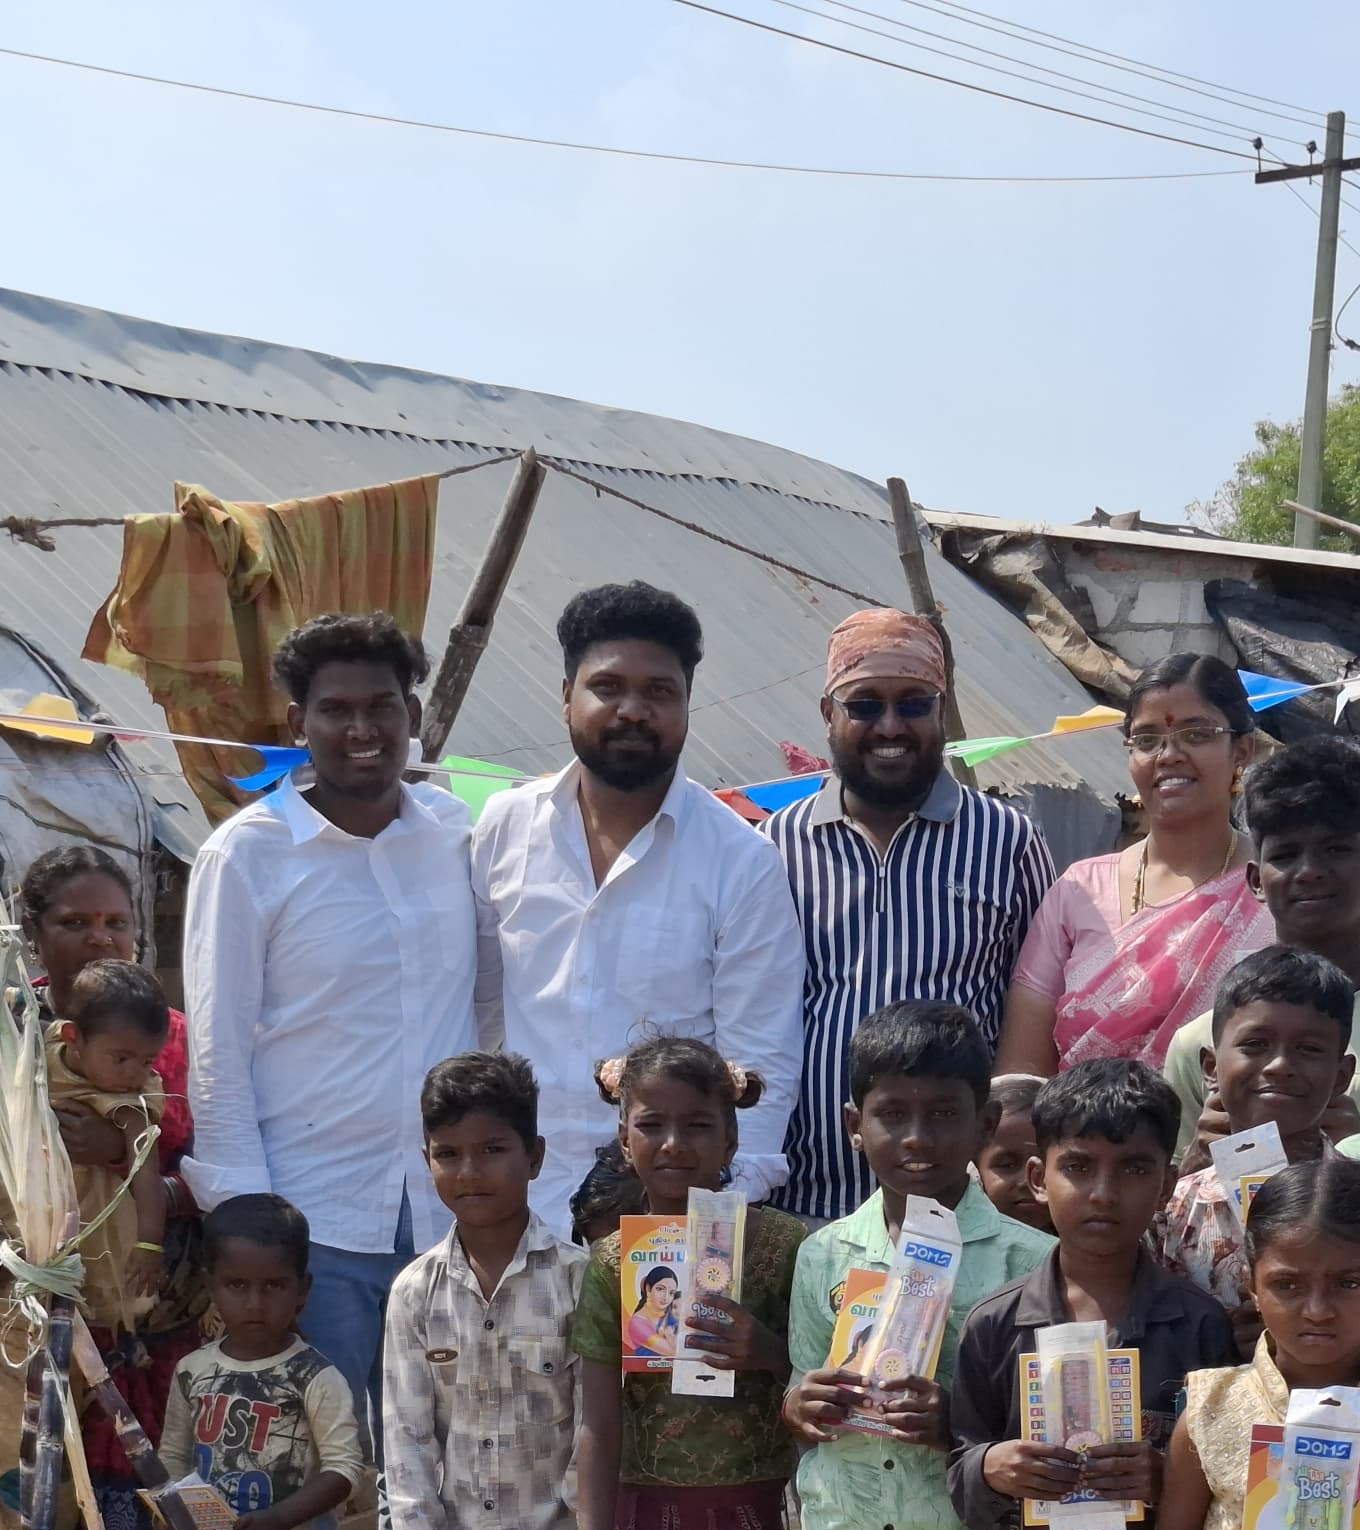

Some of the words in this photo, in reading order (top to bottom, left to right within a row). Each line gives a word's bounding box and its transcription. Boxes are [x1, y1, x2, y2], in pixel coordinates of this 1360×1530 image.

[906, 1243, 952, 1265] DOMS
[900, 1275, 936, 1298] Best
[1296, 1438, 1351, 1458] DOMS
[1297, 1472, 1340, 1501] Best
